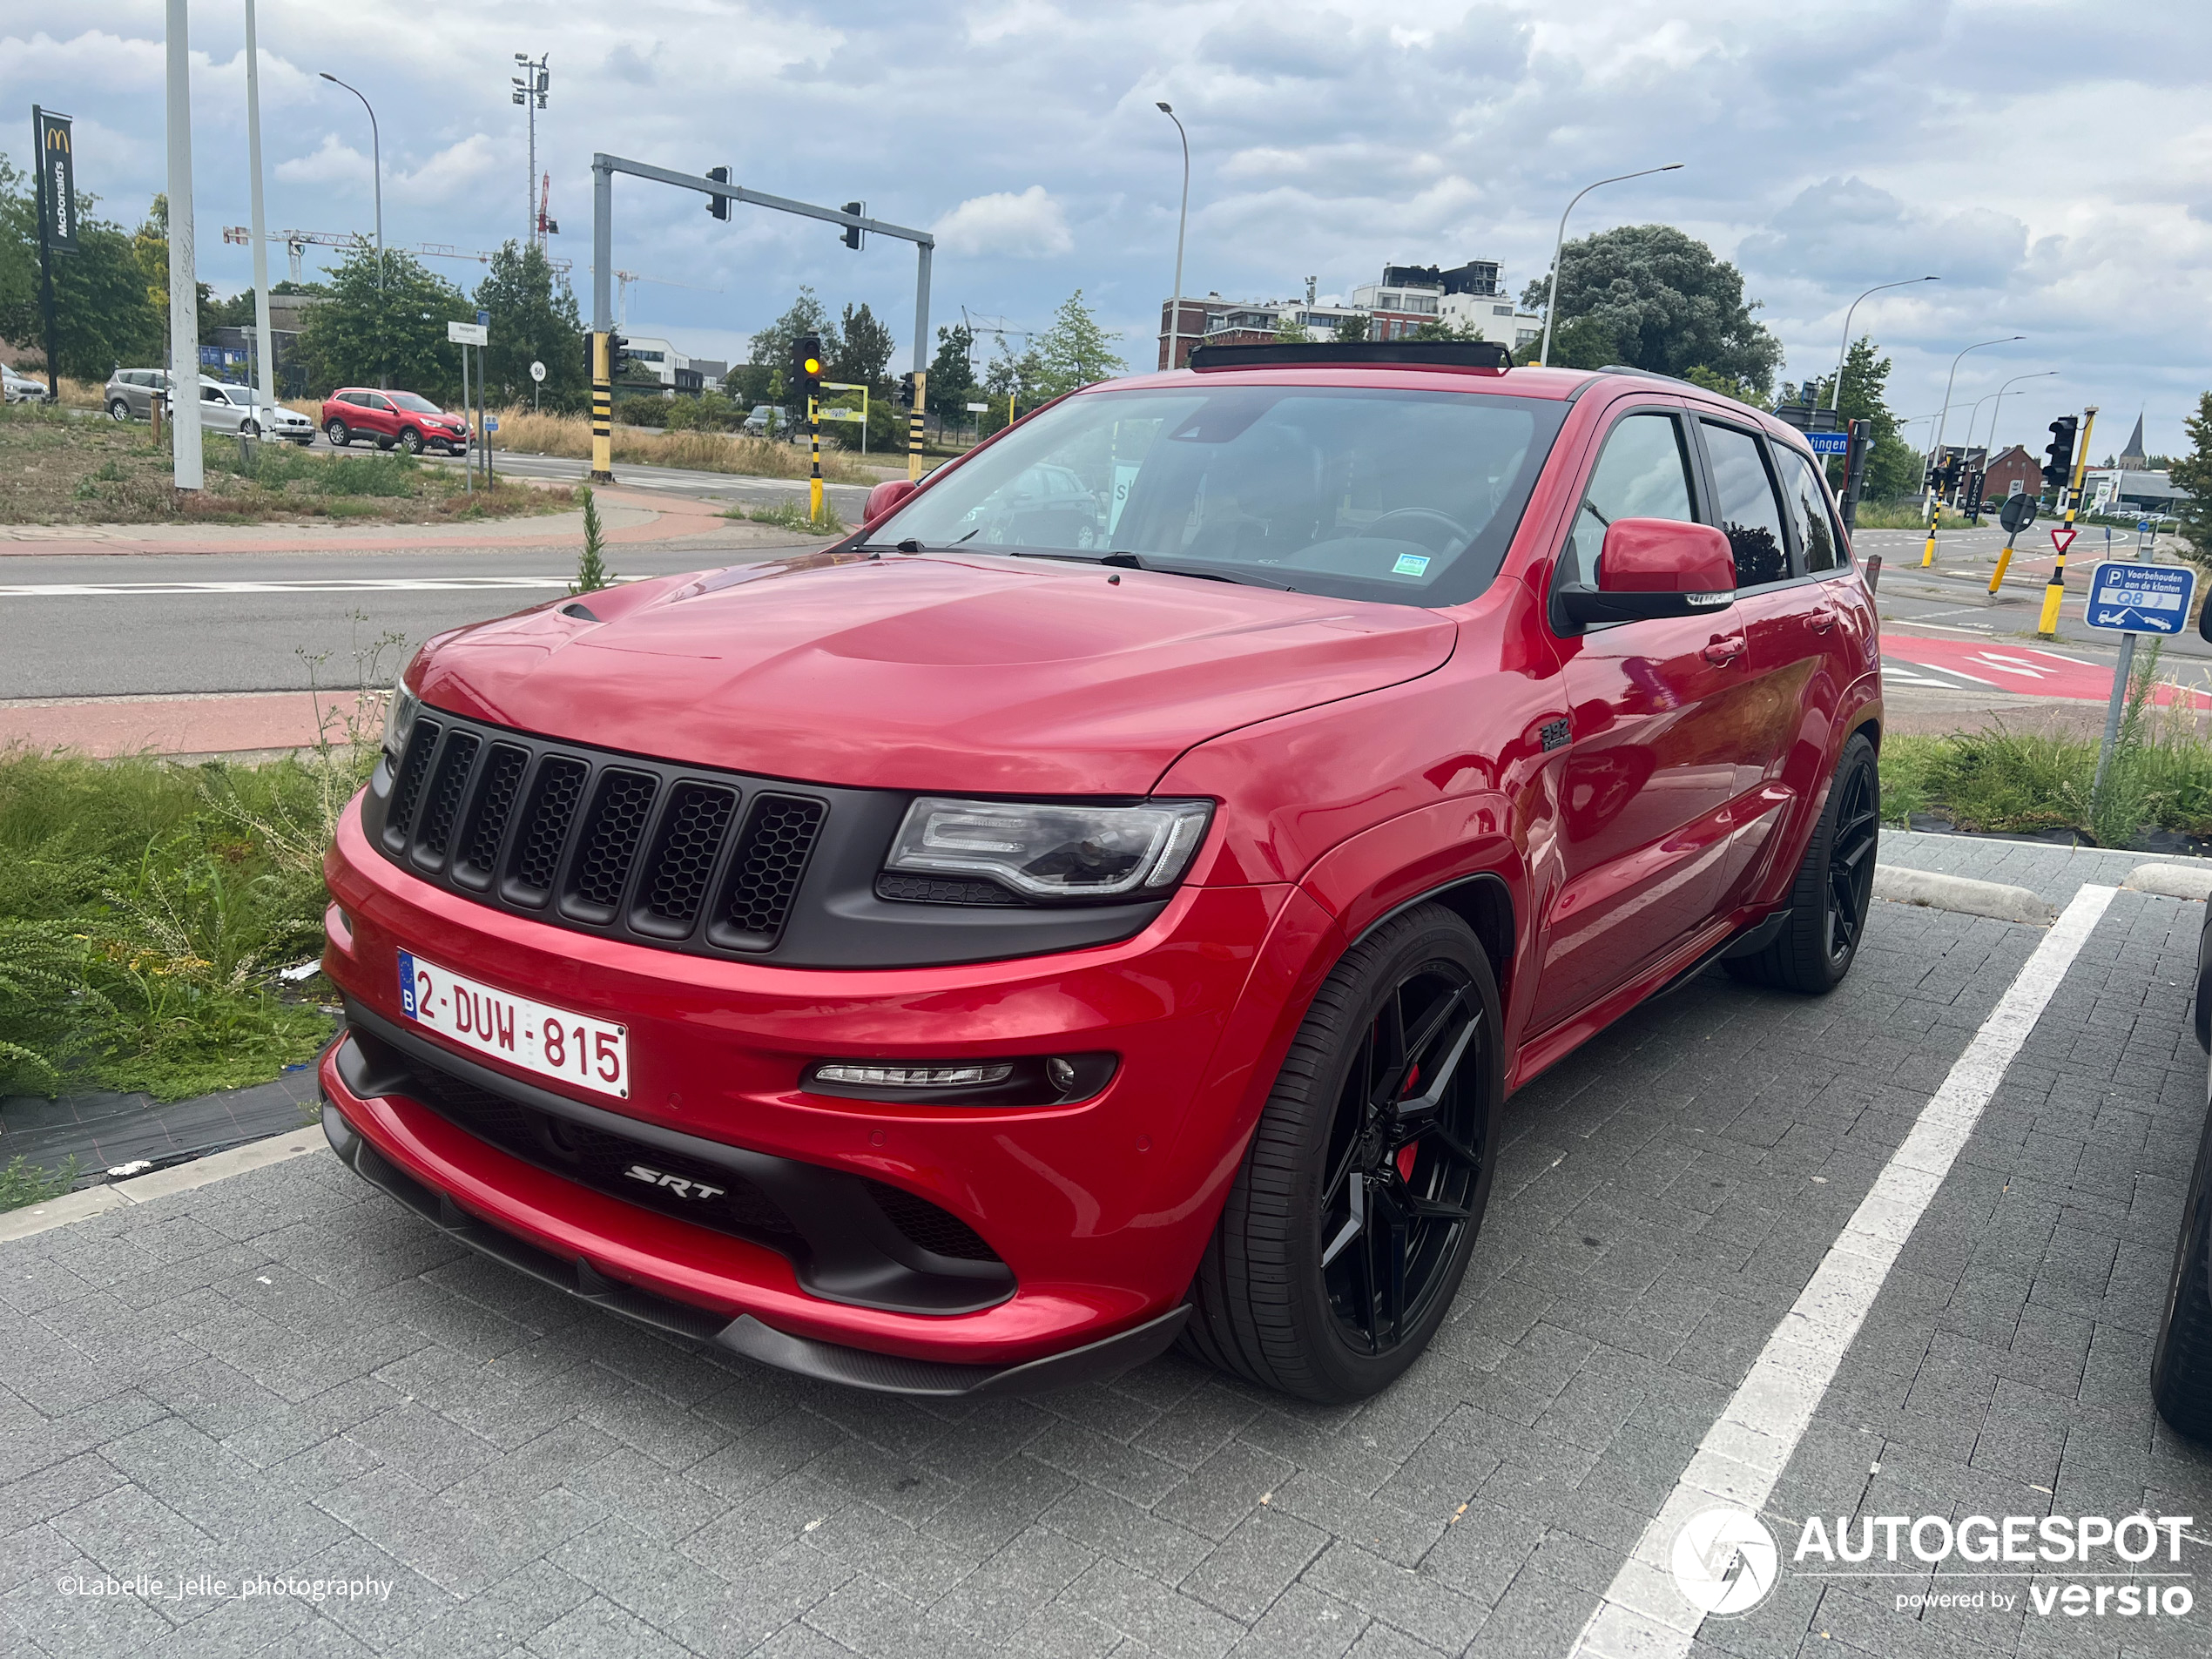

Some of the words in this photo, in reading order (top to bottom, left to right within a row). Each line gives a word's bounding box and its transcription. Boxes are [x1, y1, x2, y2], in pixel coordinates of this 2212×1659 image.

[54, 161, 68, 238] McDonald's
[535, 367, 543, 376] 50
[1811, 436, 1846, 452] tingen
[2108, 570, 2121, 584] P
[2128, 569, 2182, 583] Voorbehouden
[2125, 581, 2140, 590] aan
[2141, 581, 2151, 590] de
[2152, 582, 2181, 593] klanten
[2117, 590, 2143, 606] Q8
[1541, 717, 1569, 744] 392
[403, 989, 415, 1012] B
[417, 970, 620, 1083] 2-DUW-815
[624, 1165, 725, 1199] SRT
